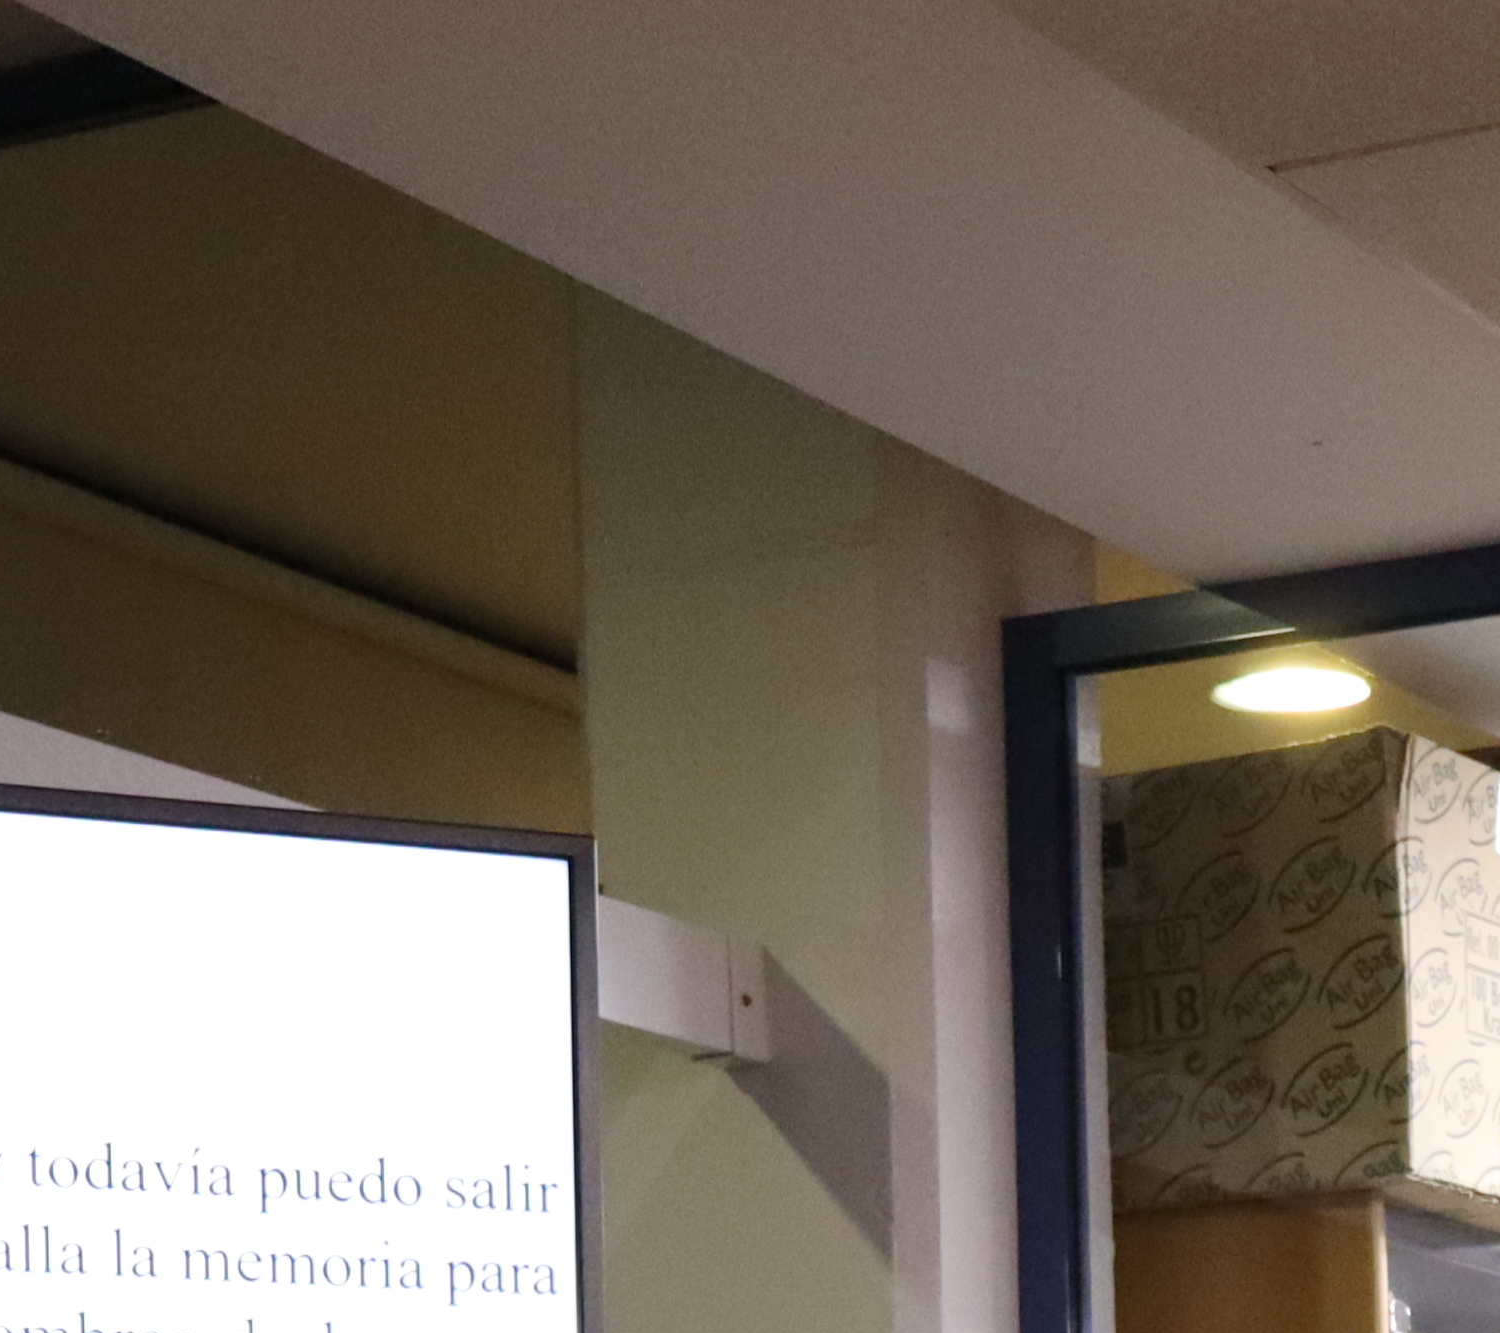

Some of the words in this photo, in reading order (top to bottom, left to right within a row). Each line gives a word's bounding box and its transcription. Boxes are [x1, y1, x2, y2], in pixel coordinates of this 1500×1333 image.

[28, 1142, 234, 1197] todavía
[259, 1157, 423, 1215] puedo
[446, 1163, 559, 1214] salir
[114, 1228, 158, 1278] la
[183, 1240, 424, 1290] memoria
[447, 1261, 558, 1307] para
